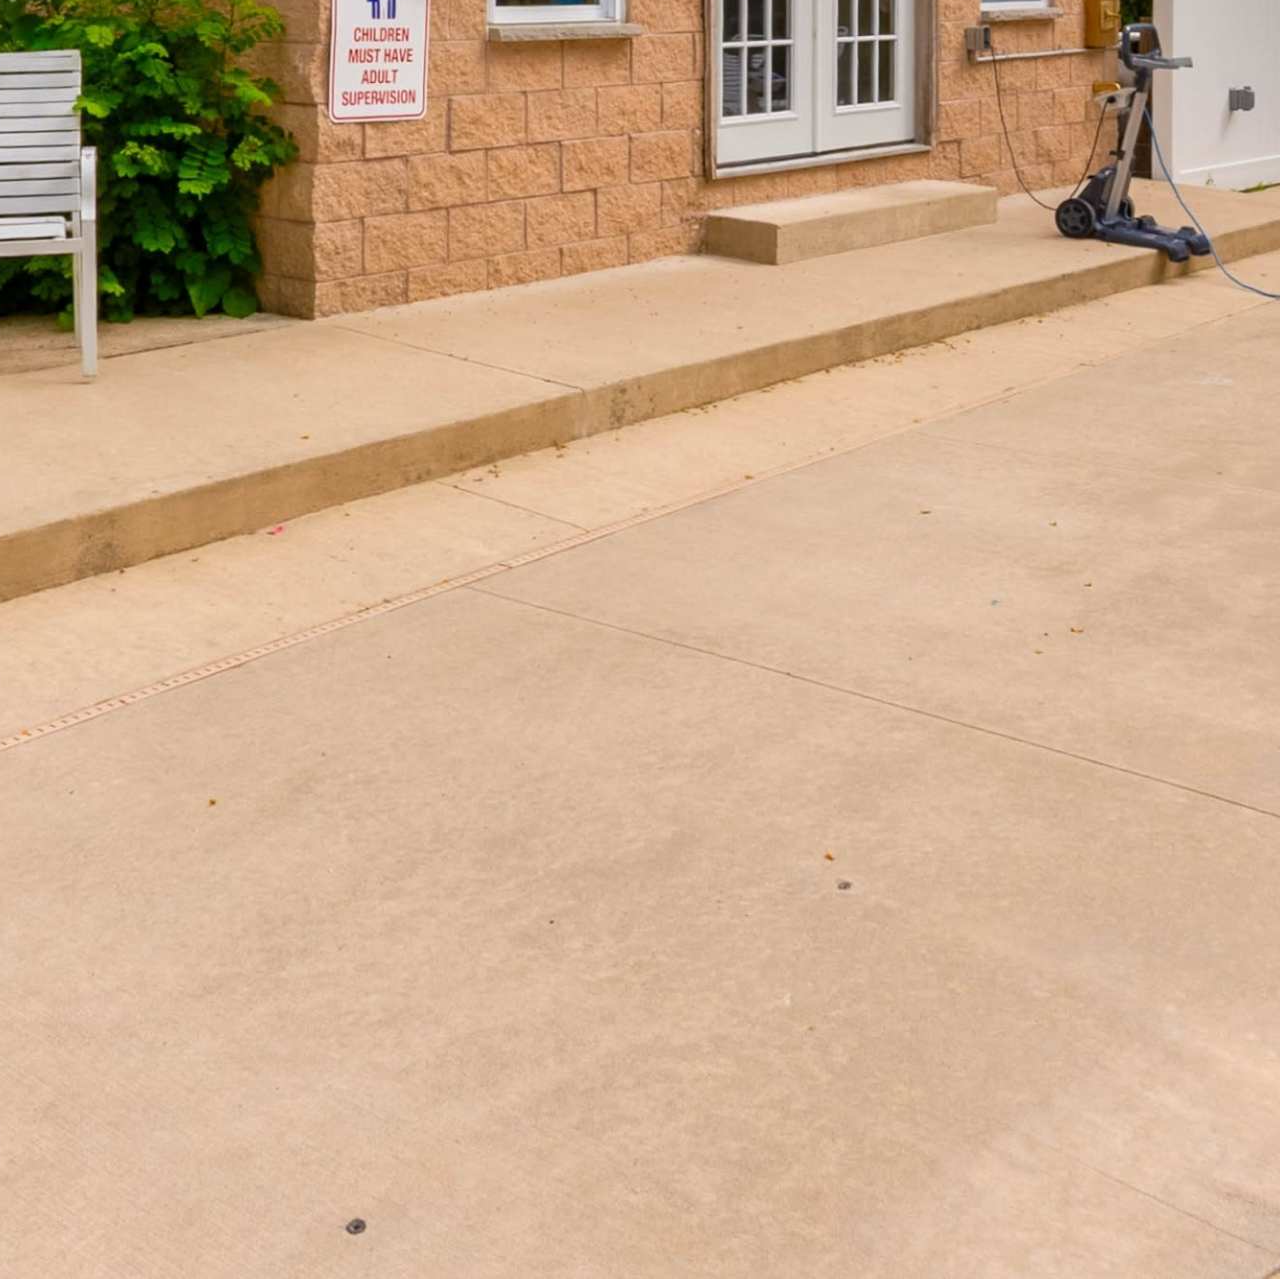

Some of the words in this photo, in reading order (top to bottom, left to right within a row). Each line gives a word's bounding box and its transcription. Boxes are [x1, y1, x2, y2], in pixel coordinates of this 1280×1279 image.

[353, 27, 410, 42] CHILDREN
[348, 49, 381, 63] MUST
[383, 49, 413, 63] HAVE
[361, 69, 399, 84] ADULT
[341, 90, 416, 106] SUPERVISION
